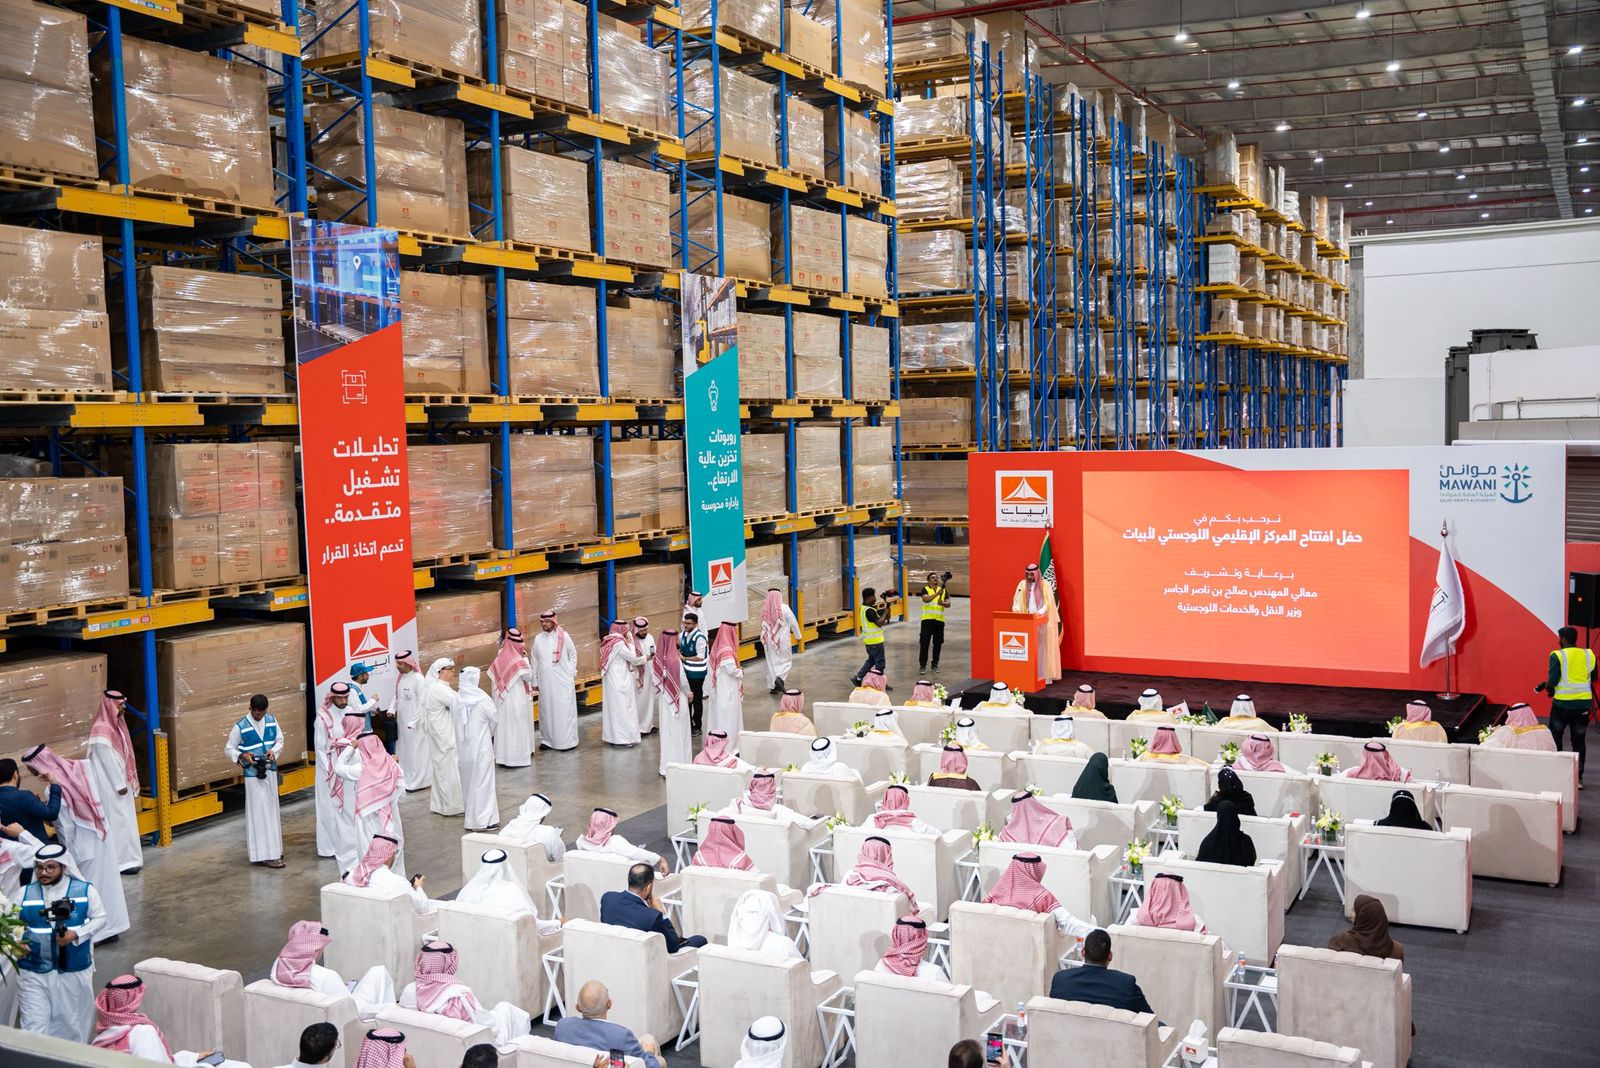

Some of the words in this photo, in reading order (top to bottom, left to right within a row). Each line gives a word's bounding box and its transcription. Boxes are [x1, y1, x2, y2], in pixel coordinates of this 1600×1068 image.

[709, 429, 737, 446] روبوتات
[333, 436, 399, 462] تحليلات
[698, 450, 716, 468] عالية
[718, 450, 737, 467] تخزين
[1440, 464, 1496, 478] موانئ
[343, 465, 401, 496] تشغيل
[1440, 479, 1496, 490] MAWANI
[701, 500, 724, 514] محوسبة
[725, 496, 739, 511] بإدارة
[324, 501, 401, 524] متقدمة..
[1209, 513, 1240, 526] بكم
[1242, 513, 1281, 525] نرحب
[1193, 514, 1207, 526] في
[1122, 526, 1155, 542] لأبيات
[1158, 528, 1209, 546] اللوجستي
[1212, 528, 1260, 547] الإقليمي
[1263, 529, 1296, 544] المركز
[1299, 530, 1333, 547] افتتاح
[1336, 530, 1363, 546] حفل
[321, 543, 349, 565] القرار
[353, 540, 377, 557] اتخاذ
[380, 539, 404, 561] تدعم
[1184, 567, 1242, 580] وتشريف
[1244, 568, 1294, 580] برعاية
[1163, 583, 1189, 595] الجاسر
[1191, 584, 1210, 595] ناصر
[1212, 588, 1223, 597] بن
[1224, 585, 1248, 599] صالح
[1249, 586, 1289, 599] المهندس
[1291, 587, 1318, 602] معالي
[1177, 602, 1218, 614] اللوجستية
[1219, 603, 1259, 616] والخدمات
[1261, 605, 1284, 617] النقل
[1286, 607, 1302, 618] وزير
